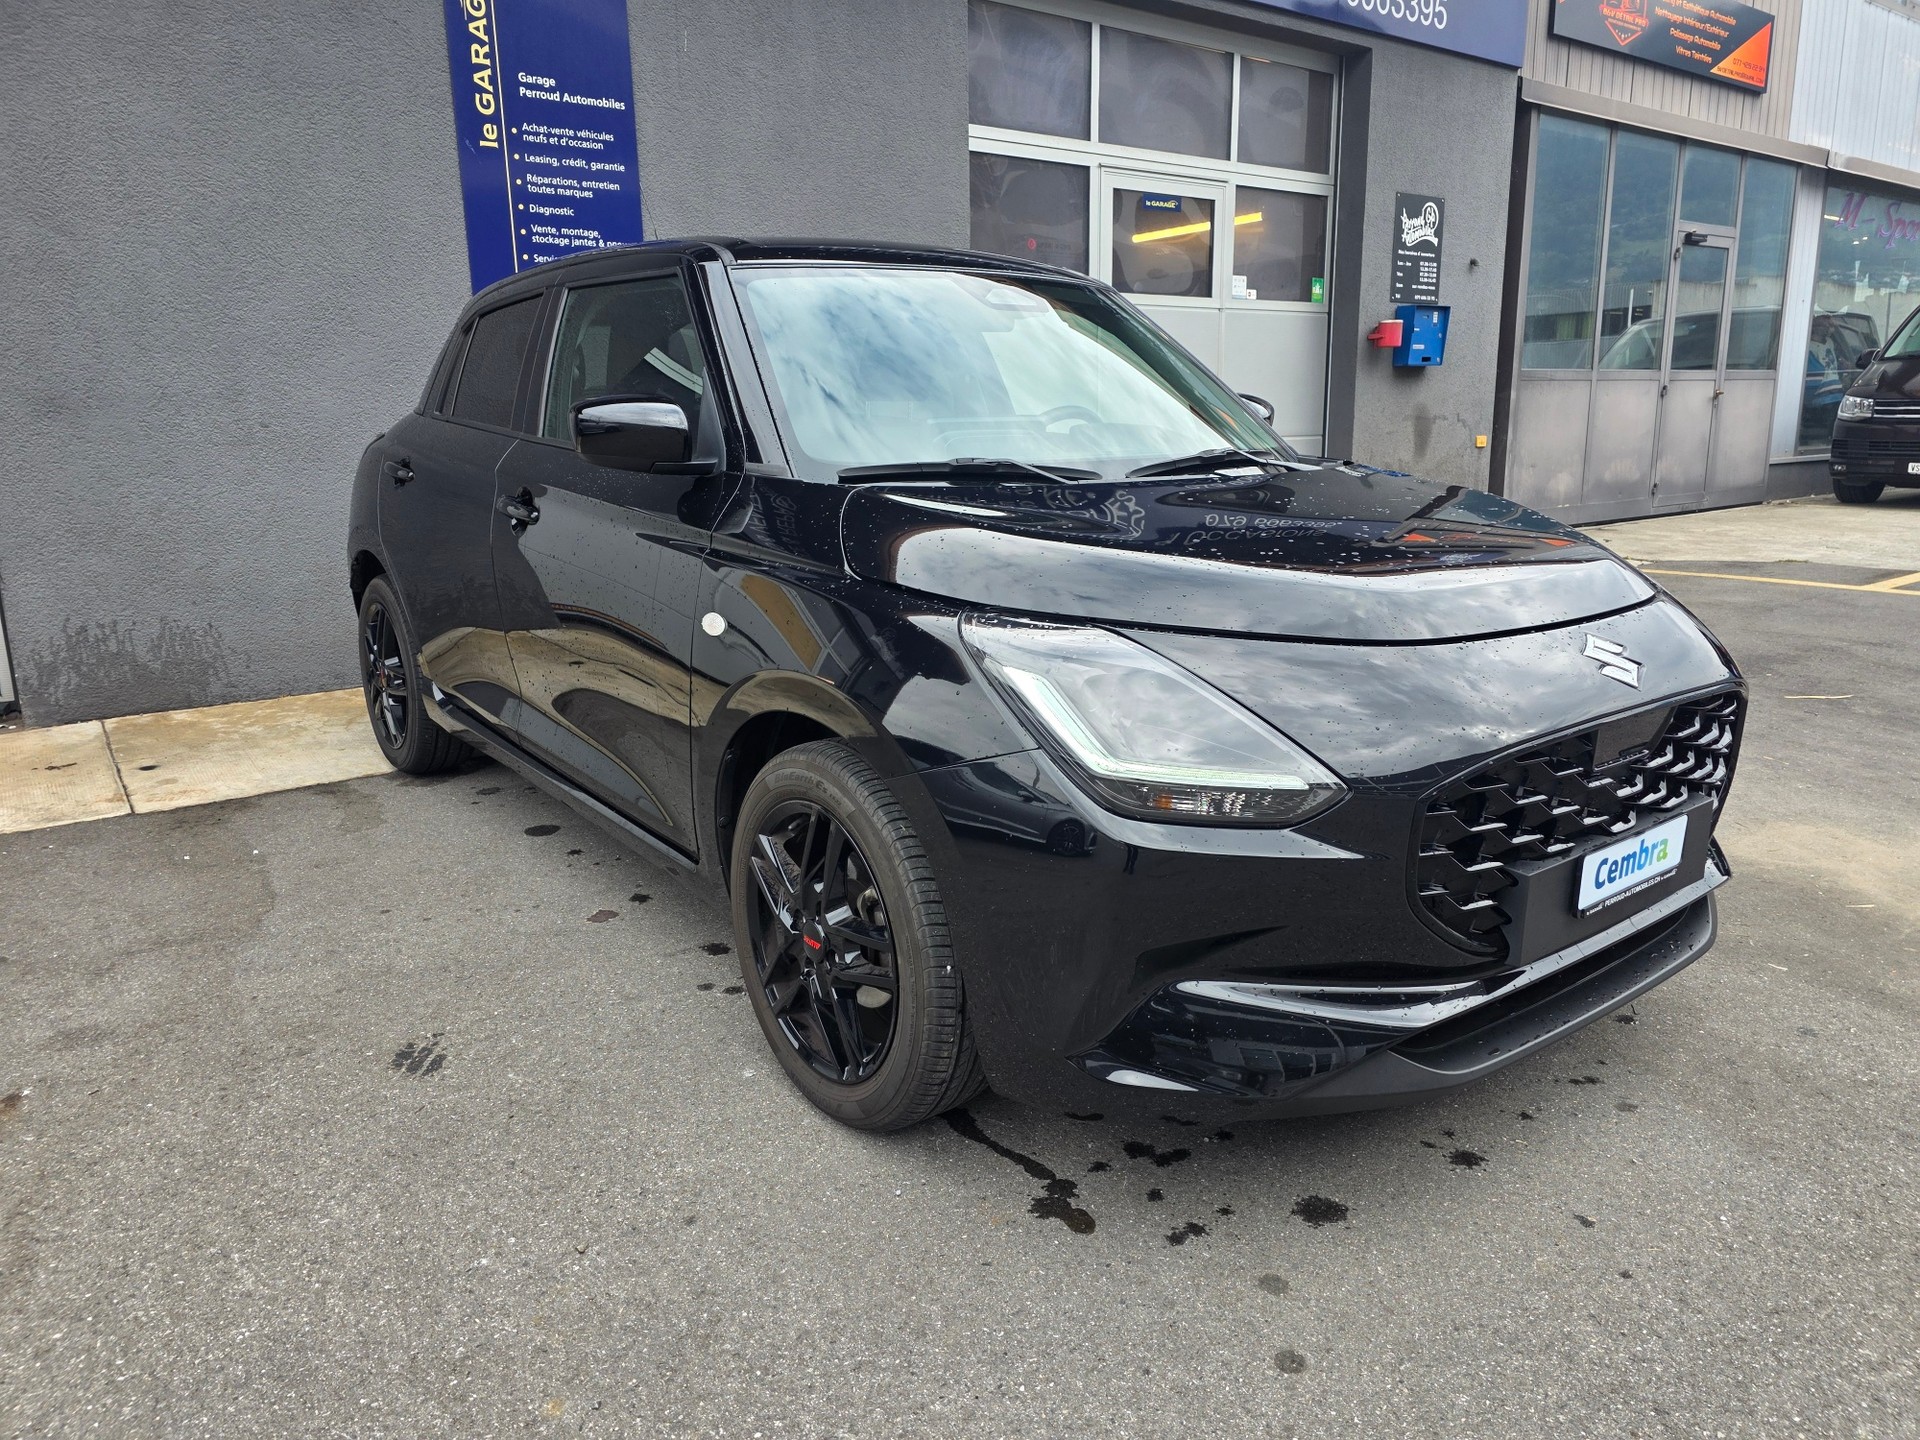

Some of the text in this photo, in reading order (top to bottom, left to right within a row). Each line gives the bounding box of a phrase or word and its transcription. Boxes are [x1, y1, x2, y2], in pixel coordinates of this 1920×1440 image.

[1654, 6, 1683, 24] Nettoyage
[1709, 10, 1737, 26] Automobile
[1669, 27, 1722, 51] Polissage Automobile
[1675, 45, 1713, 64] Vitres Teintées
[518, 72, 556, 88] Garage
[519, 86, 626, 110] Perroud Automobiles
[479, 123, 499, 149] le
[522, 122, 614, 142] Achat-vente véhicules
[523, 133, 604, 150] neufs et d'occasion
[524, 153, 626, 173] Leasing, crédit, garantie
[526, 173, 620, 191] Réparations, entretien
[527, 183, 594, 199] toutes marques
[529, 204, 575, 217] Diagnostic
[1151, 200, 1176, 209] GARAGE
[531, 224, 601, 239] Vente, montage,
[531, 234, 570, 247] stockage
[571, 237, 597, 248] jantes
[598, 239, 605, 248] &
[1594, 838, 1669, 890] Cembra
